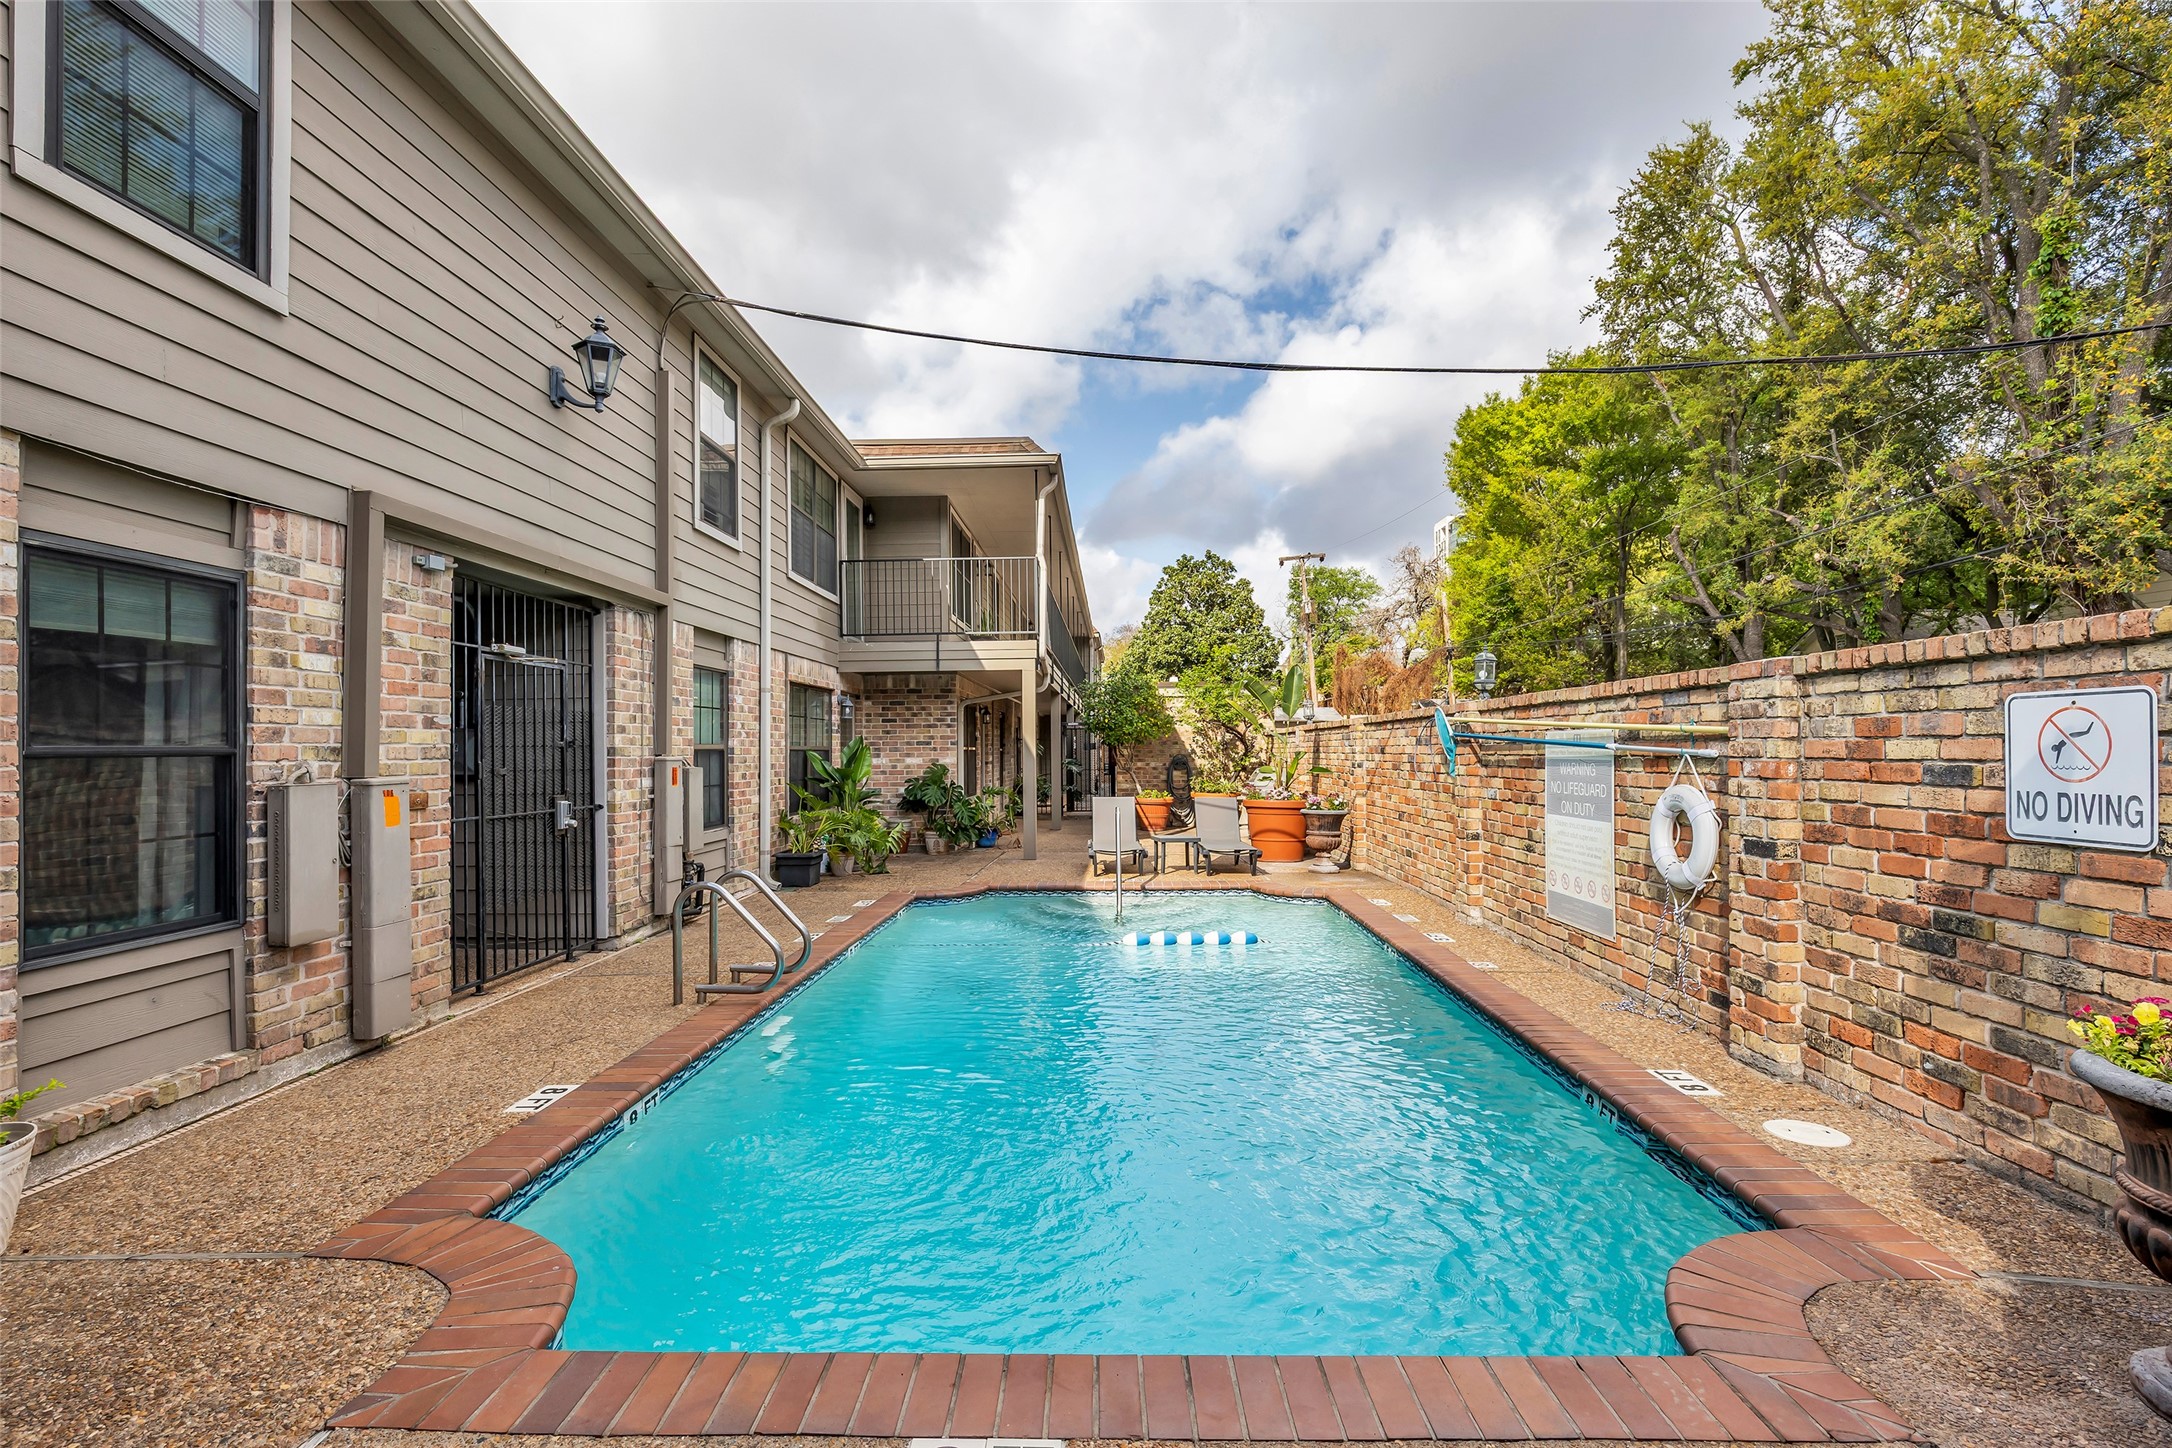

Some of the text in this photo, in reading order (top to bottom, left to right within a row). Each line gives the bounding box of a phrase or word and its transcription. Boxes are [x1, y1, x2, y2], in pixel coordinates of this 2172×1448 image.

[1559, 762, 1596, 777] WARNING
[1551, 781, 1607, 798] NO LIFEGUARD
[1561, 800, 1596, 817] ON DUTY
[2016, 790, 2144, 829] NO DIVING
[1654, 1070, 1708, 1092] 8 FT
[515, 1098, 554, 1111] FT
[629, 1092, 659, 1126] 8 FT
[1599, 1105, 1616, 1125] FT
